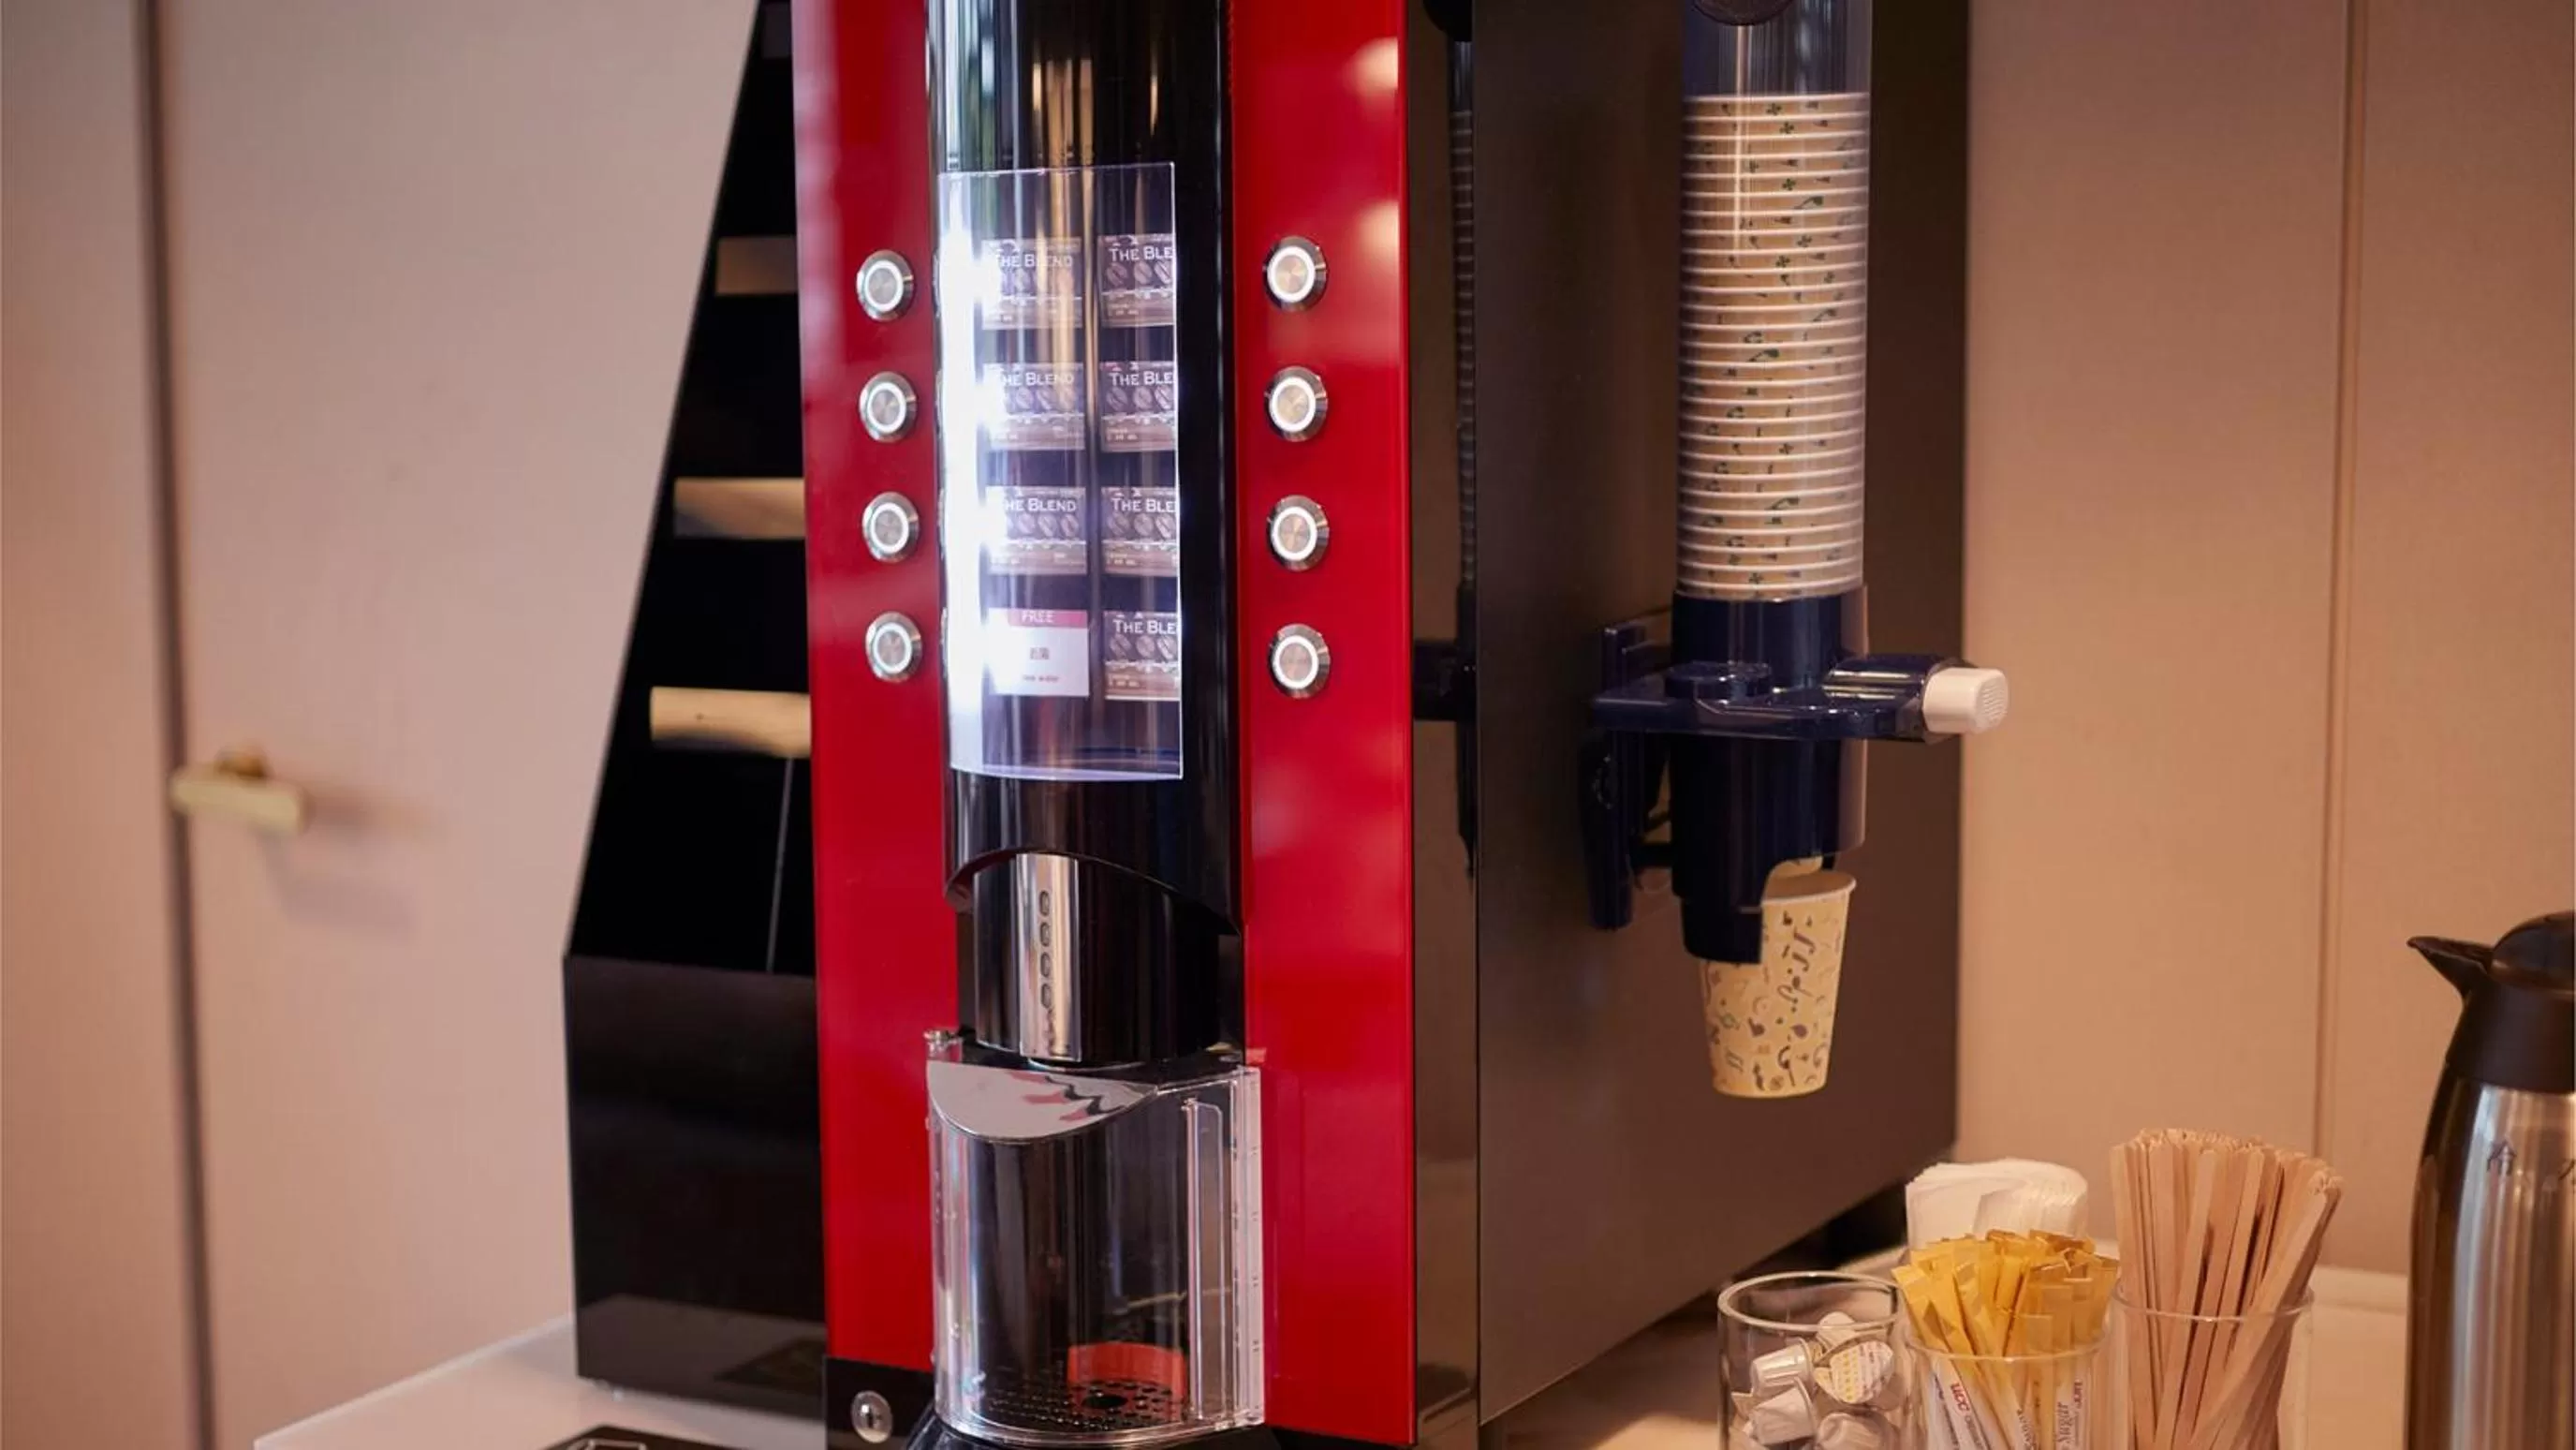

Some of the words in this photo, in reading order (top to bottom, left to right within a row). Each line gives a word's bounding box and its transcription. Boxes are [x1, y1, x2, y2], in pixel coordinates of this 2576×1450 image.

[1109, 247, 1140, 261] THE
[1109, 372, 1140, 386] THE
[1028, 497, 1076, 511] BLEND
[1111, 497, 1141, 511] THE
[1146, 498, 1177, 512] BLE
[1112, 619, 1143, 633] THE
[1147, 620, 1179, 634] BLE
